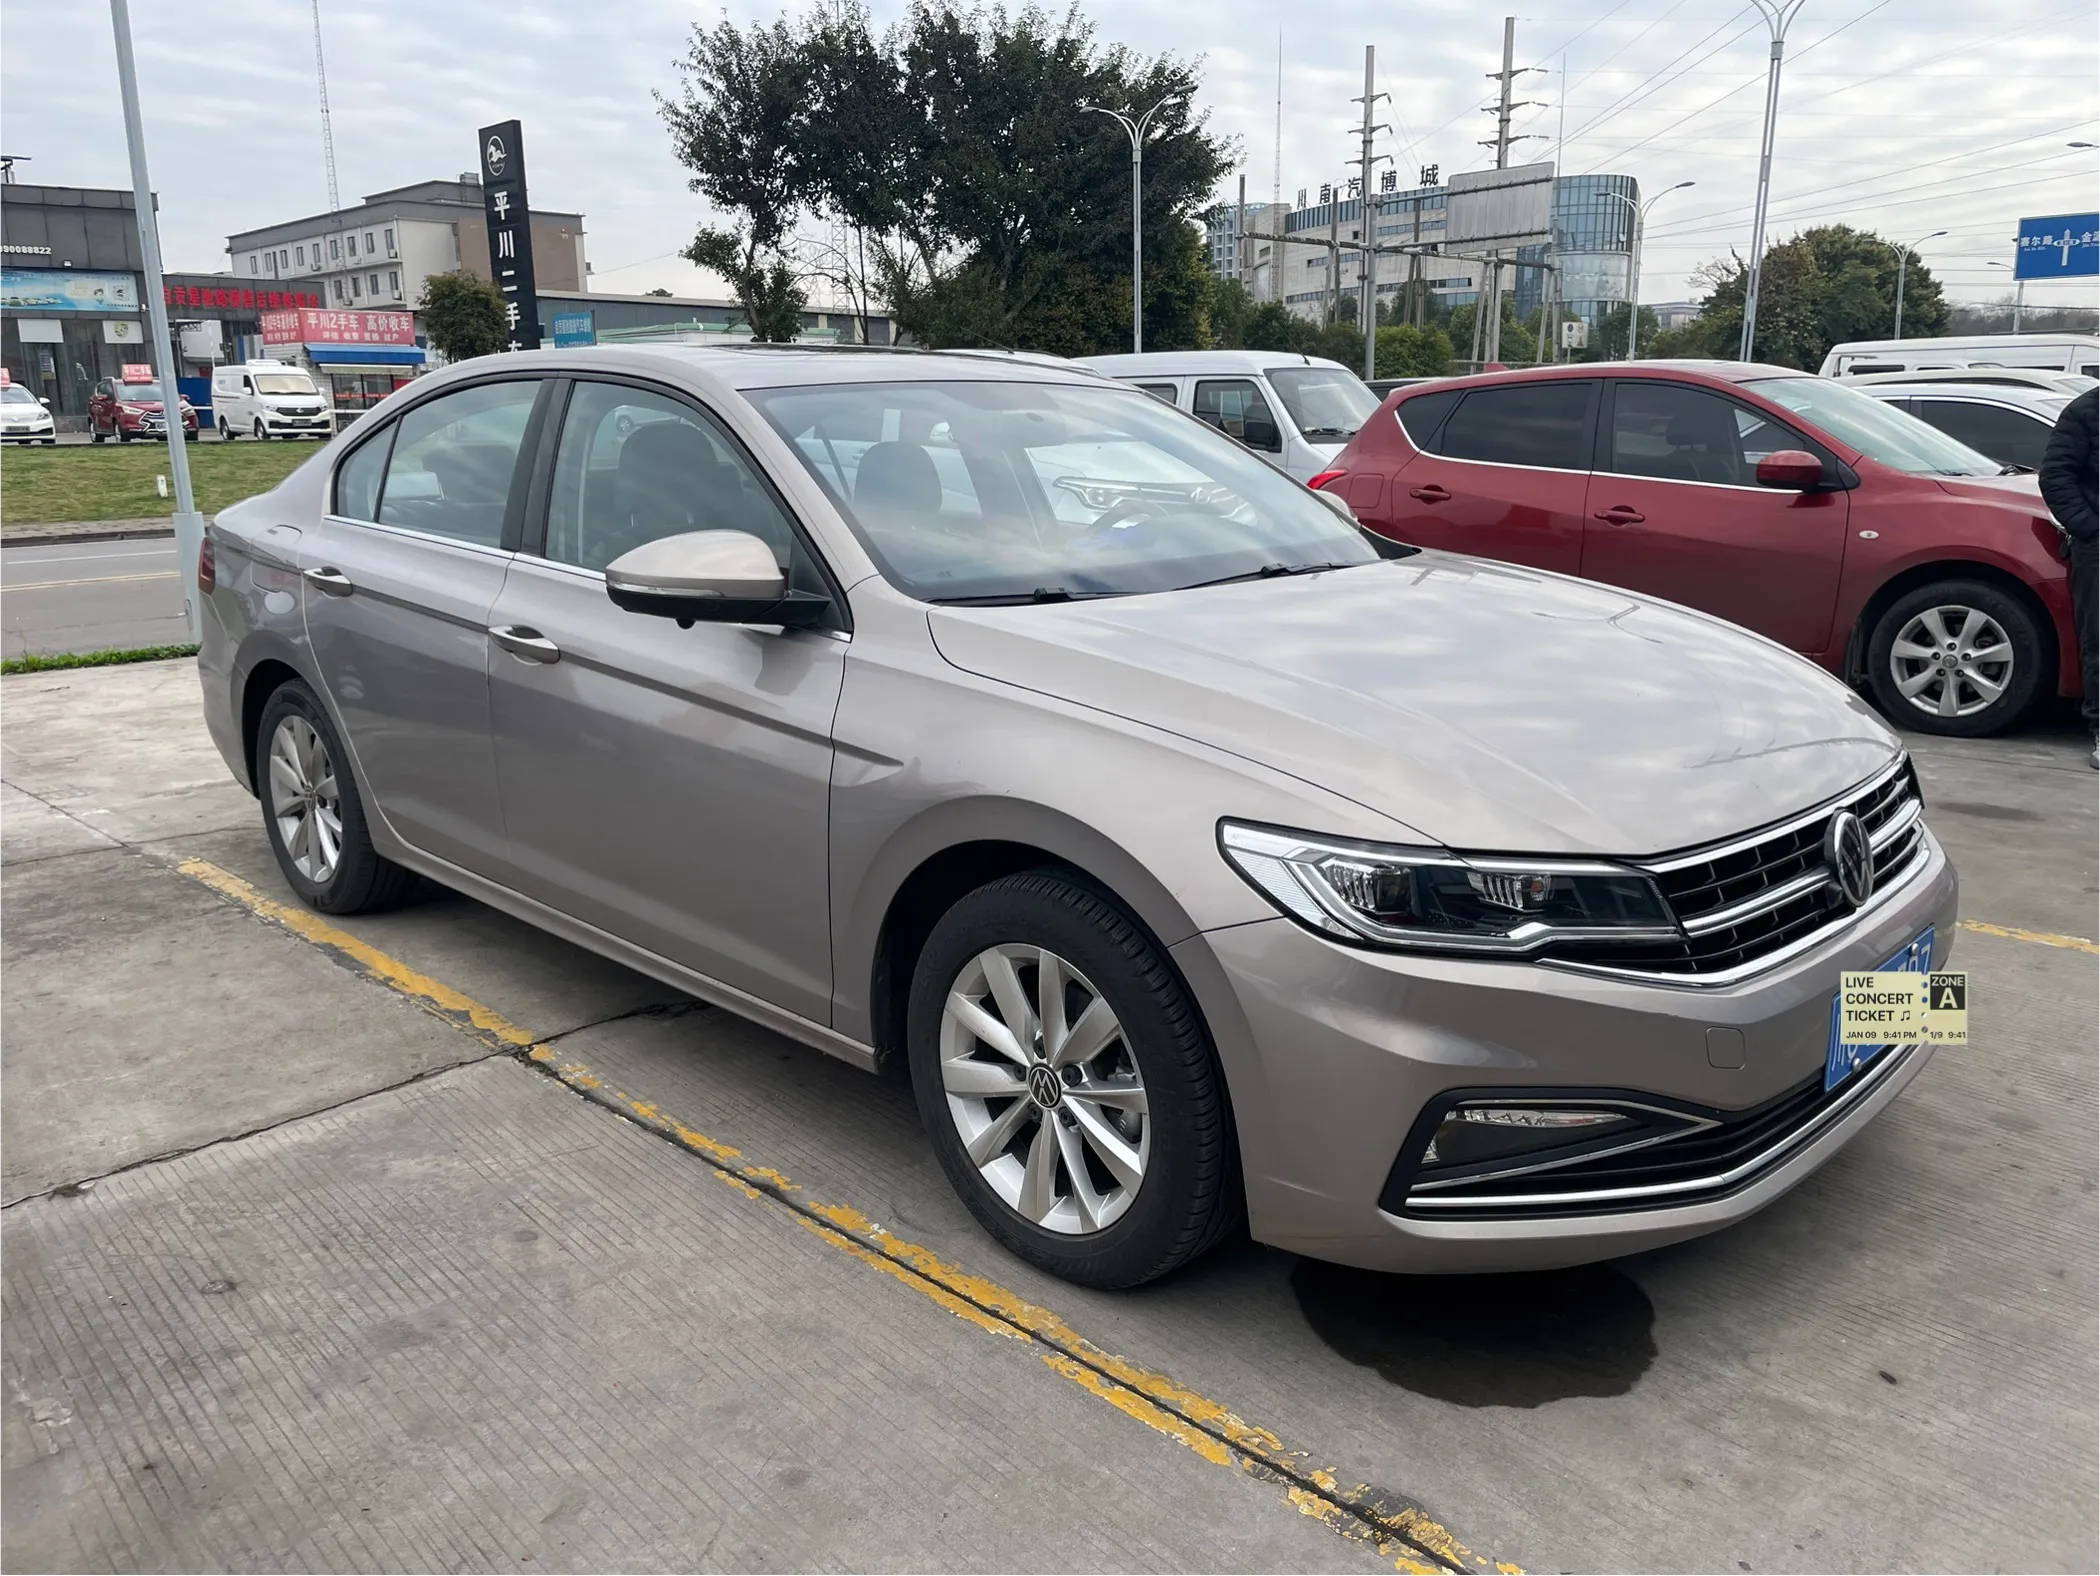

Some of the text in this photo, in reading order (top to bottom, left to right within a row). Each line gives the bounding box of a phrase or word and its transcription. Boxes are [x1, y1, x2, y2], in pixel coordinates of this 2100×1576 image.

[1296, 164, 1439, 210] 川南汽博城
[307, 312, 410, 332] 平川2手车 高价收车
